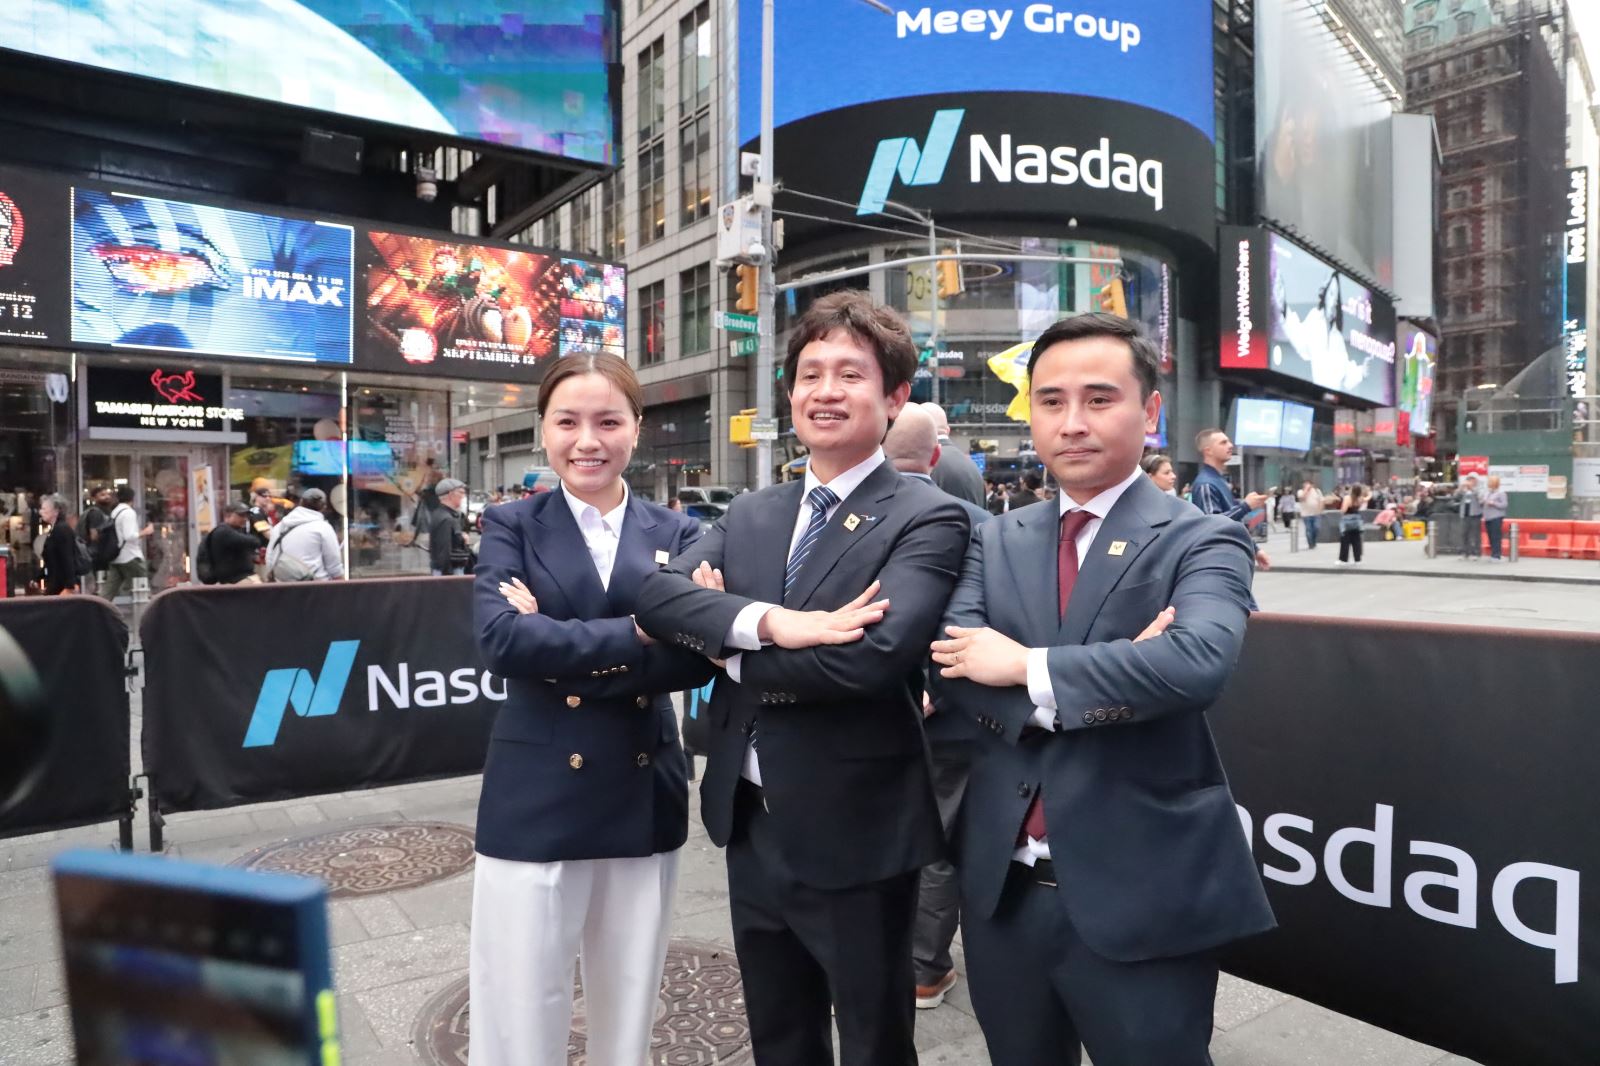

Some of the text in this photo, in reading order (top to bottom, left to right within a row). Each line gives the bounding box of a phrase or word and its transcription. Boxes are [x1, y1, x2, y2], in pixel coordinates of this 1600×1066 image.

[896, 3, 1141, 52] Meey Group
[970, 134, 1163, 211] Nasdaq
[242, 275, 345, 307] IMAX
[1236, 239, 1252, 357] WeightWatchers
[11, 304, 33, 319] 12
[724, 315, 756, 333] Broadway
[745, 338, 754, 352] 43
[522, 354, 536, 365] 12
[95, 401, 152, 416] TAMASHII
[206, 406, 244, 421] STORE
[140, 416, 204, 428] NEW YORK
[1235, 803, 1580, 984] sdaq
